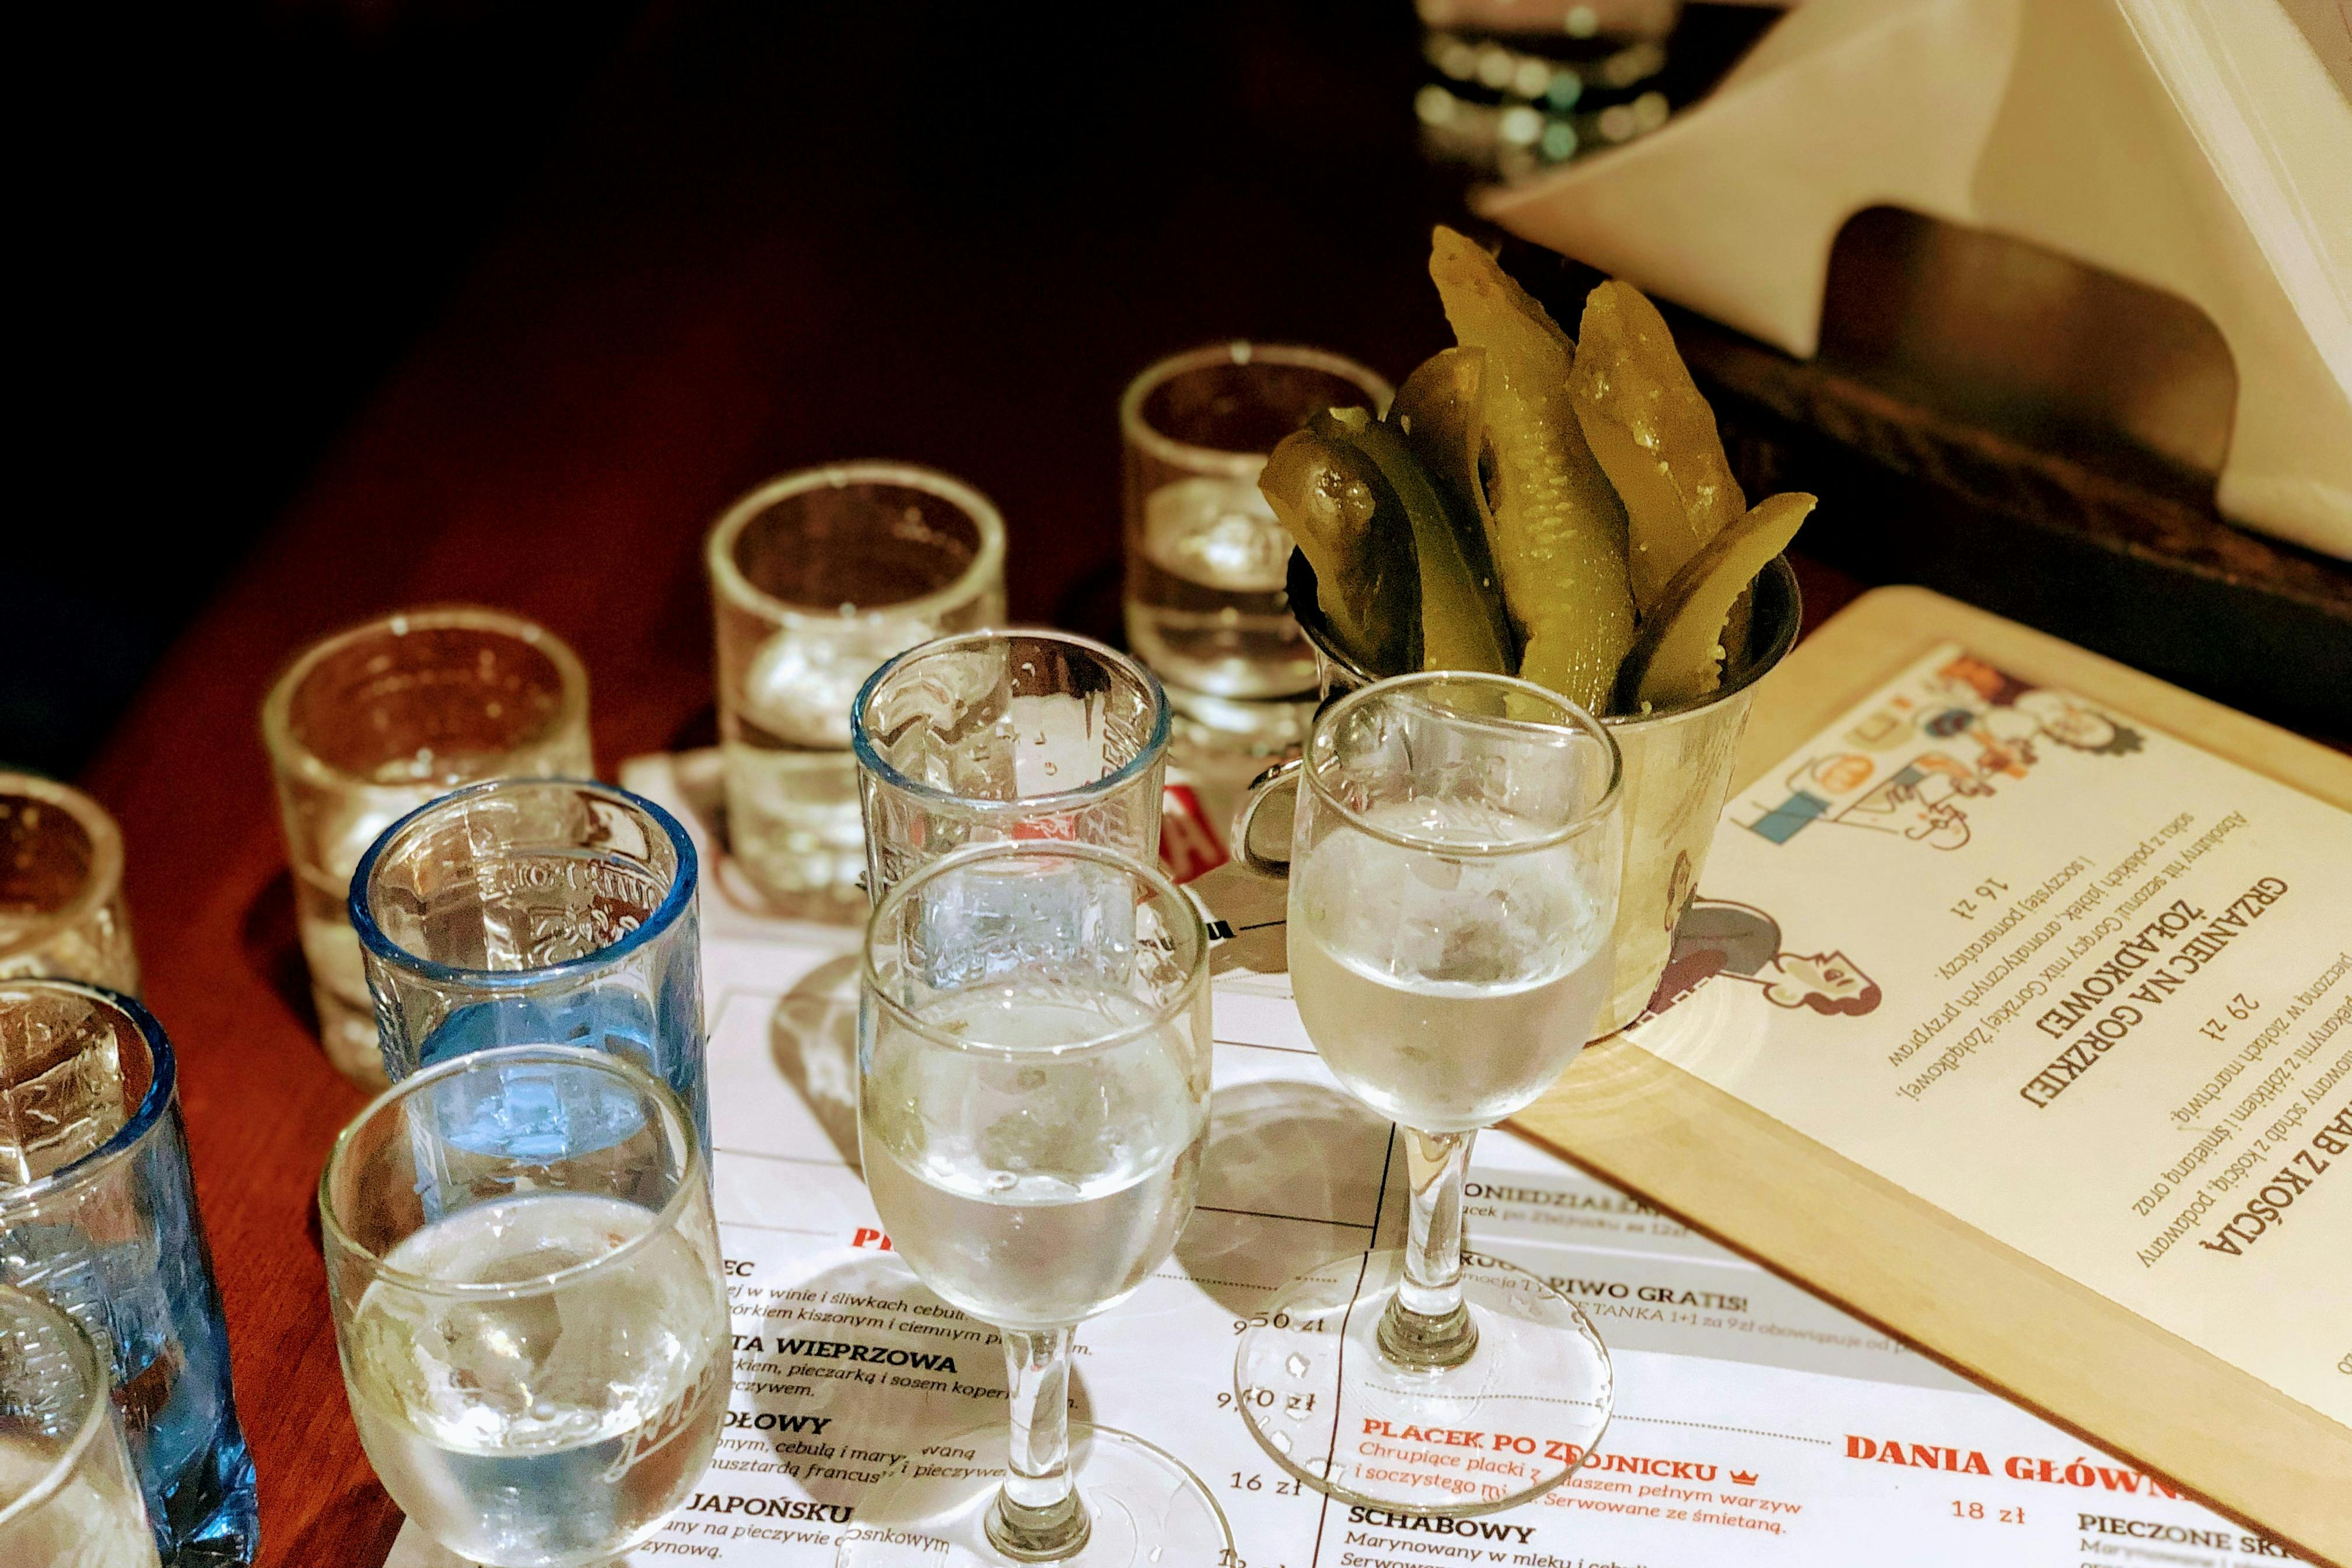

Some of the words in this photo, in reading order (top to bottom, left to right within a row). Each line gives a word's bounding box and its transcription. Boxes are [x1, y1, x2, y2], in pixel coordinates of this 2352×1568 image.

[2098, 840, 2157, 888] polskich
[1973, 876, 2010, 901] 16
[2016, 859, 2085, 914] soczystej
[2053, 881, 2109, 922] jabłek,
[1948, 898, 1978, 921] zł
[2174, 875, 2289, 975] GRZANIEC
[1933, 905, 2027, 981] pomarańczy.
[2065, 915, 2124, 961] Gorący
[1954, 919, 2063, 1008] aromatycznych
[2034, 897, 2208, 1041] ŻOŁĄDKOWEJ
[2038, 956, 2073, 983] mix
[2126, 960, 2187, 1006] NA
[1978, 979, 2049, 1034] Gorzkiej
[2224, 991, 2260, 1021] 29
[2284, 1003, 2306, 1021] w
[1887, 1001, 1963, 1068] przypraw
[2197, 1017, 2228, 1042] zł
[2237, 1016, 2291, 1062] ziołach
[1894, 1026, 1994, 1102] Żołądkowej,
[2018, 1003, 2144, 1110] GORZKIEJ
[2283, 1056, 2302, 1071] z
[2228, 1065, 2295, 1122] żółtkiem
[2263, 1101, 2309, 1142] schab
[2311, 1100, 2352, 1156] AB
[2159, 1124, 2234, 1185] śmietaną
[2252, 1138, 2272, 1153] z
[2205, 1147, 2268, 1193] kością,
[2291, 1147, 2331, 1184] Z
[2130, 1181, 2171, 1217] oraz
[2197, 1164, 2314, 1257] KOŚCIĄ
[2135, 1188, 2217, 1269] podawany
[748, 1287, 764, 1297] w
[769, 1287, 817, 1302] winie
[820, 1290, 828, 1302] i
[830, 1290, 908, 1312] śliwkach
[1549, 1276, 1629, 1299] PIWO
[1637, 1286, 1748, 1312] GRATIS!
[797, 1308, 887, 1329] kiszonym
[888, 1317, 897, 1330] i
[898, 1320, 981, 1341] ciemnym
[1594, 1303, 1664, 1322] TANKA
[1671, 1311, 1698, 1326] 1+1
[1702, 1317, 1723, 1329] za
[776, 1337, 958, 1374] WIEPRZOWA
[786, 1363, 876, 1385] pieczarką
[881, 1371, 888, 1384] i
[890, 1374, 947, 1392] sosem
[775, 1440, 835, 1459] cebulą
[840, 1445, 849, 1458] i
[1362, 1417, 1486, 1449] PLACEK
[1492, 1433, 1537, 1455] PO
[1843, 1434, 1994, 1476] DANIA
[901, 1460, 909, 1474] i
[1230, 1471, 1262, 1491] 16
[1275, 1478, 1303, 1496] zł
[1359, 1441, 1462, 1468] Chrupiące
[1465, 1457, 1525, 1478] placki
[1637, 1484, 1714, 1504] pełnym
[1719, 1493, 1803, 1514] warzyw
[685, 1493, 855, 1524] JAPOŃSKU
[1354, 1463, 1363, 1478] i
[1365, 1466, 1476, 1495] soczystego
[1544, 1492, 1662, 1518] Serwowane
[1665, 1507, 1688, 1520] ze
[1692, 1508, 1787, 1535] śmietaną.
[1951, 1500, 1985, 1520] 18
[1999, 1506, 2025, 1524] zł
[704, 1523, 729, 1535] na
[731, 1524, 830, 1545] pieczywie
[1347, 1505, 1536, 1545] SCHABOWY
[2077, 1513, 2232, 1551] PIECZONE
[1344, 1530, 1483, 1562] Marynowany
[1488, 1551, 1507, 1563] w
